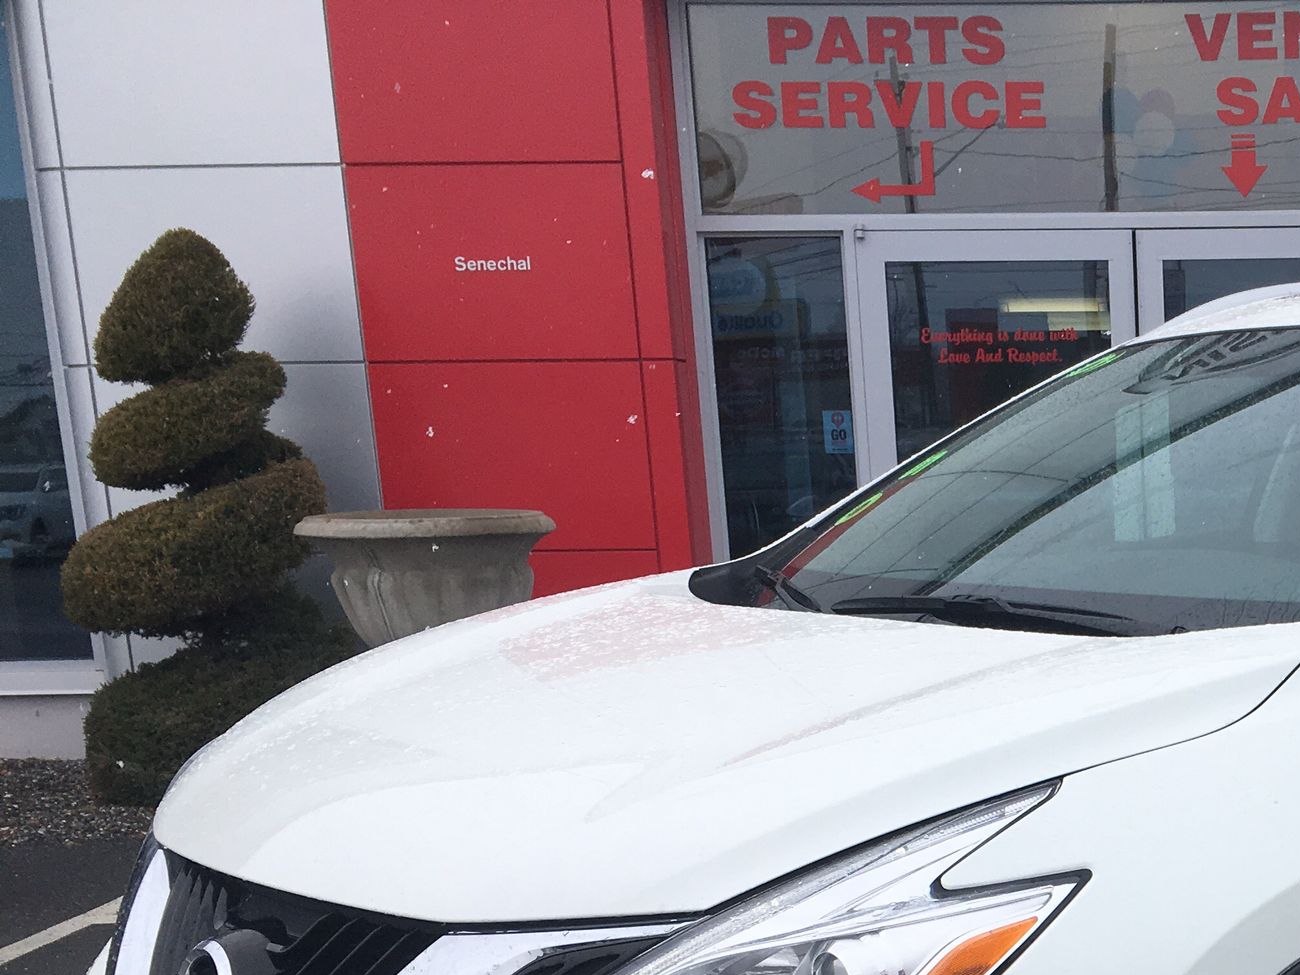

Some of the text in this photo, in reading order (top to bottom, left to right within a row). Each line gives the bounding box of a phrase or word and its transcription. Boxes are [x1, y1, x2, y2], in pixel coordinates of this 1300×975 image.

[767, 15, 1005, 66] PARTS
[732, 79, 1047, 129] SERVICE
[454, 255, 531, 271] Senechal
[921, 326, 1079, 346] Everything is done with
[938, 347, 971, 364] Love
[976, 347, 1004, 363] And
[830, 428, 847, 441] GO
